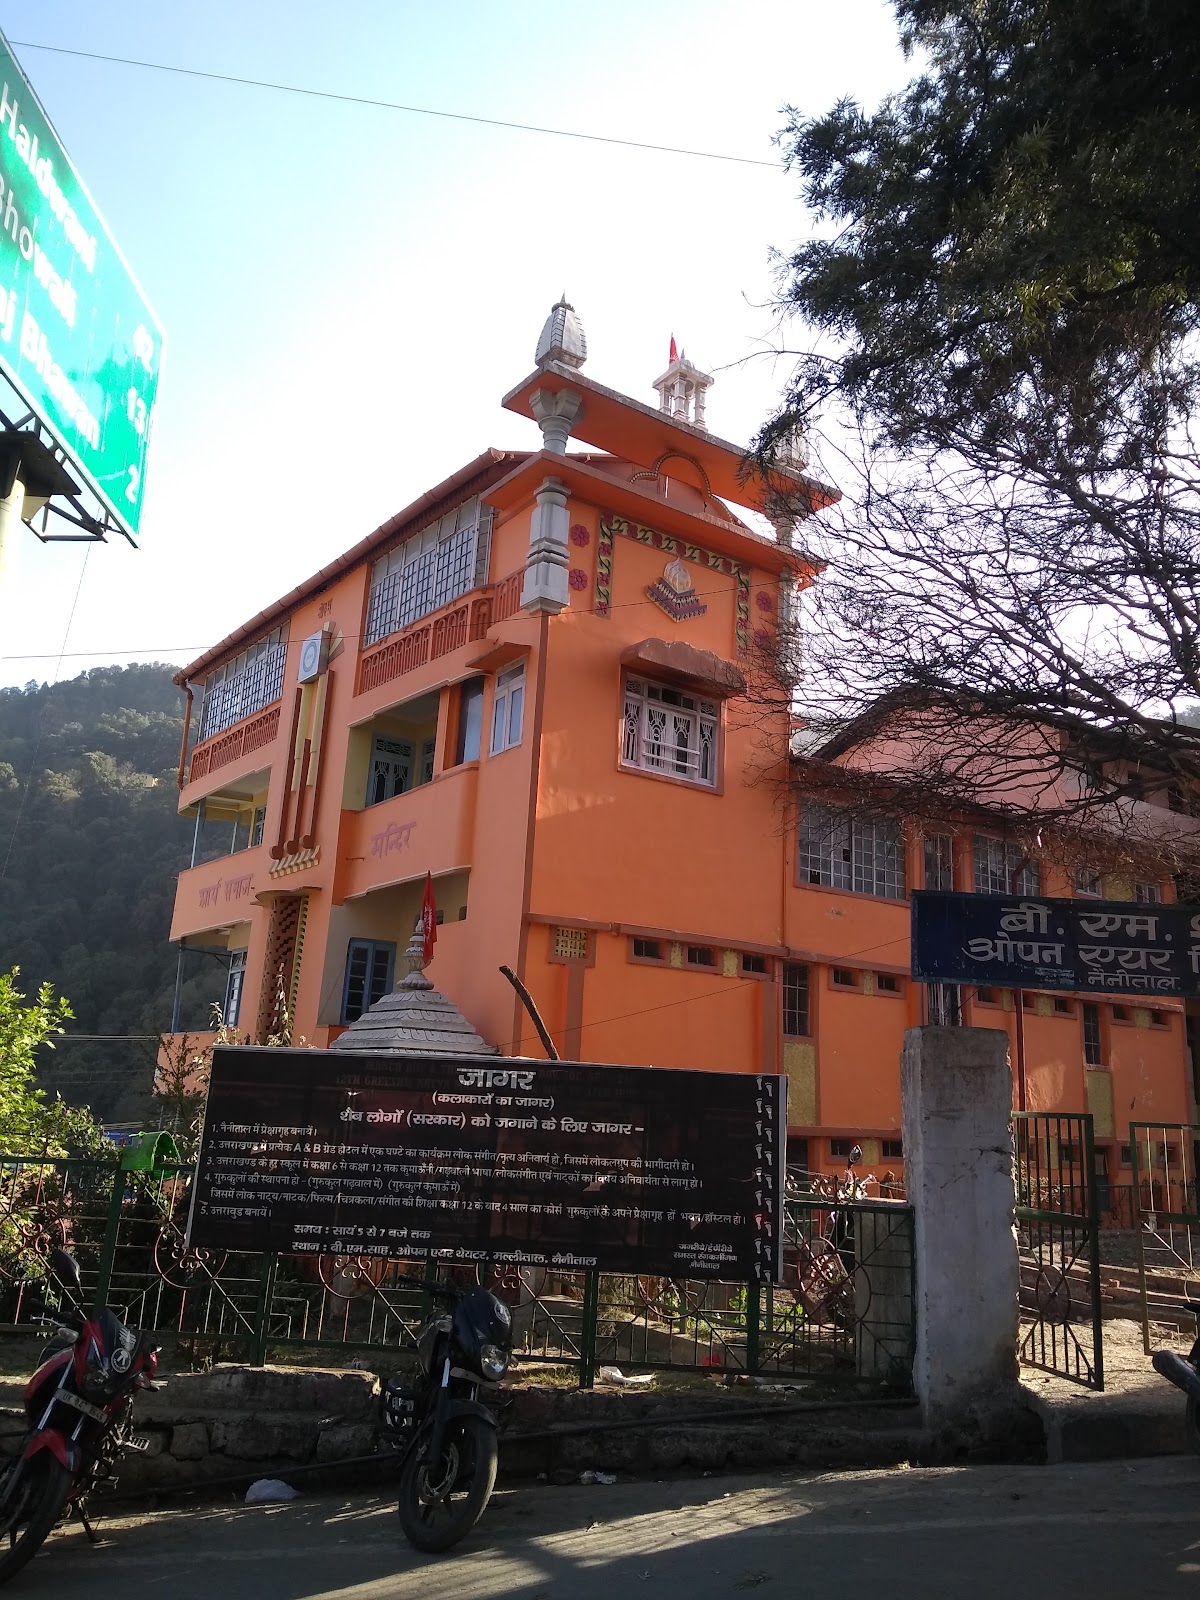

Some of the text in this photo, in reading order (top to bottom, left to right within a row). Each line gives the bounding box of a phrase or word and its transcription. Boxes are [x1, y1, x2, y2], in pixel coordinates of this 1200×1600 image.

[961, 932, 1065, 965] ओपन
[1078, 944, 1174, 972] एयर
[456, 1067, 536, 1090] जागर
[432, 1090, 555, 1110] (कलाकारों का जागर)
[220, 1121, 251, 1134] नैनीताल
[366, 1108, 404, 1124] लोगों
[406, 1109, 466, 1130] (सरकार)
[470, 1113, 492, 1127] को
[494, 1115, 538, 1130] जगाने
[541, 1117, 557, 1131] के
[560, 1117, 588, 1133] लिए
[209, 1140, 216, 1150] 2.
[218, 1141, 259, 1151] उत्तराखण्ड
[268, 1142, 293, 1153] प्रत्येक
[293, 1143, 302, 1153] A
[303, 1143, 311, 1153] &
[313, 1144, 321, 1153] B
[337, 1143, 360, 1155] होटल
[361, 1143, 369, 1155] में
[369, 1147, 384, 1158] एक
[405, 1149, 417, 1157] का
[418, 1147, 452, 1158] कार्यक्रम
[452, 1148, 473, 1159] लोक
[516, 1152, 550, 1163] अनिवार्य
[564, 1153, 588, 1165] जिसमें
[630, 1156, 642, 1169] की
[644, 1158, 681, 1171] भागीदारी
[204, 1173, 212, 1181] 4.
[214, 1171, 247, 1186] गुरुकुलों
[247, 1172, 260, 1184] की
[261, 1174, 290, 1185] स्थापना
[291, 1174, 300, 1186] हो
[207, 1156, 214, 1165] 3.
[216, 1156, 257, 1167] उत्तराखण्ड
[258, 1156, 267, 1168] के
[302, 1157, 310, 1169] में
[310, 1160, 331, 1171] कक्षा
[332, 1163, 338, 1171] 6
[340, 1159, 348, 1170] से
[348, 1162, 369, 1173] कक्षा
[371, 1164, 381, 1173] 12
[383, 1164, 399, 1173] तक
[581, 1175, 594, 1183] का
[662, 1175, 670, 1186] से
[210, 1187, 235, 1199] जिसमें
[235, 1188, 256, 1200] लोक
[401, 1196, 414, 1207] की
[415, 1196, 438, 1209] शिक्षा
[440, 1200, 460, 1210] कक्षा
[461, 1201, 473, 1210] 12
[474, 1199, 483, 1211] के
[502, 1203, 508, 1211] 4
[509, 1203, 529, 1213] साल
[529, 1205, 542, 1213] का
[543, 1203, 562, 1215] कोर्स
[611, 1206, 632, 1218] अपने
[294, 1224, 323, 1234] समय
[332, 1224, 357, 1236] सायं
[357, 1227, 364, 1236] 5
[366, 1225, 378, 1237] से
[379, 1228, 386, 1237] 7
[410, 1229, 432, 1239] तक
[292, 1241, 320, 1251] स्थान
[395, 1244, 428, 1257] ओपन
[551, 1252, 598, 1266] नैनीताल
